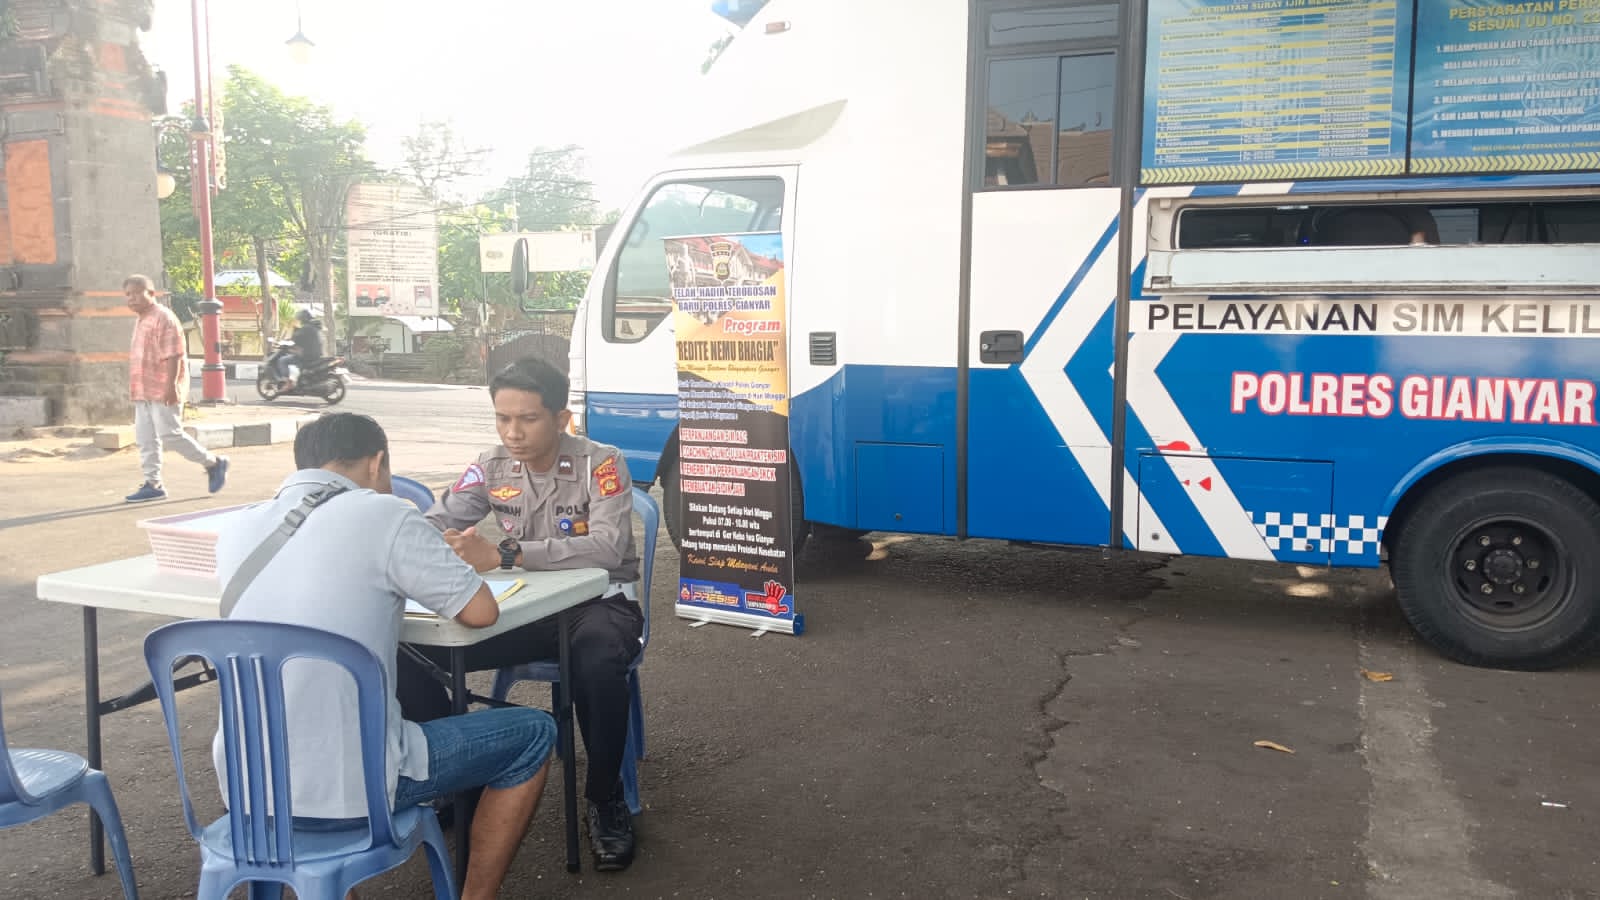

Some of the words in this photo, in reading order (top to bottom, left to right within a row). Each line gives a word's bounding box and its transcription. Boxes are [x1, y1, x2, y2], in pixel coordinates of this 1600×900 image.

[1450, 1, 1555, 19] PERSYARATAN
[1468, 16, 1521, 31] SESUAI
[1526, 15, 1547, 28] UU
[703, 301, 732, 311] POLRES
[735, 300, 770, 310] GIANYAR
[724, 318, 781, 334] Program
[1148, 303, 1378, 331] PELAYANAN
[1392, 304, 1464, 333] SIM
[1482, 304, 1600, 334] KELIL
[710, 340, 737, 361] NEMU
[1231, 371, 1393, 418] POLRES
[1401, 374, 1598, 425] GIANYAR
[773, 449, 786, 464] SIM
[708, 504, 727, 515] Datang
[727, 505, 743, 517] Setiap
[743, 506, 754, 516] Hari
[754, 508, 773, 520] Minggu
[698, 540, 712, 551] tetap
[713, 543, 737, 552] mematuhi
[738, 544, 757, 554] Protokol
[758, 546, 786, 558] Kesehatan
